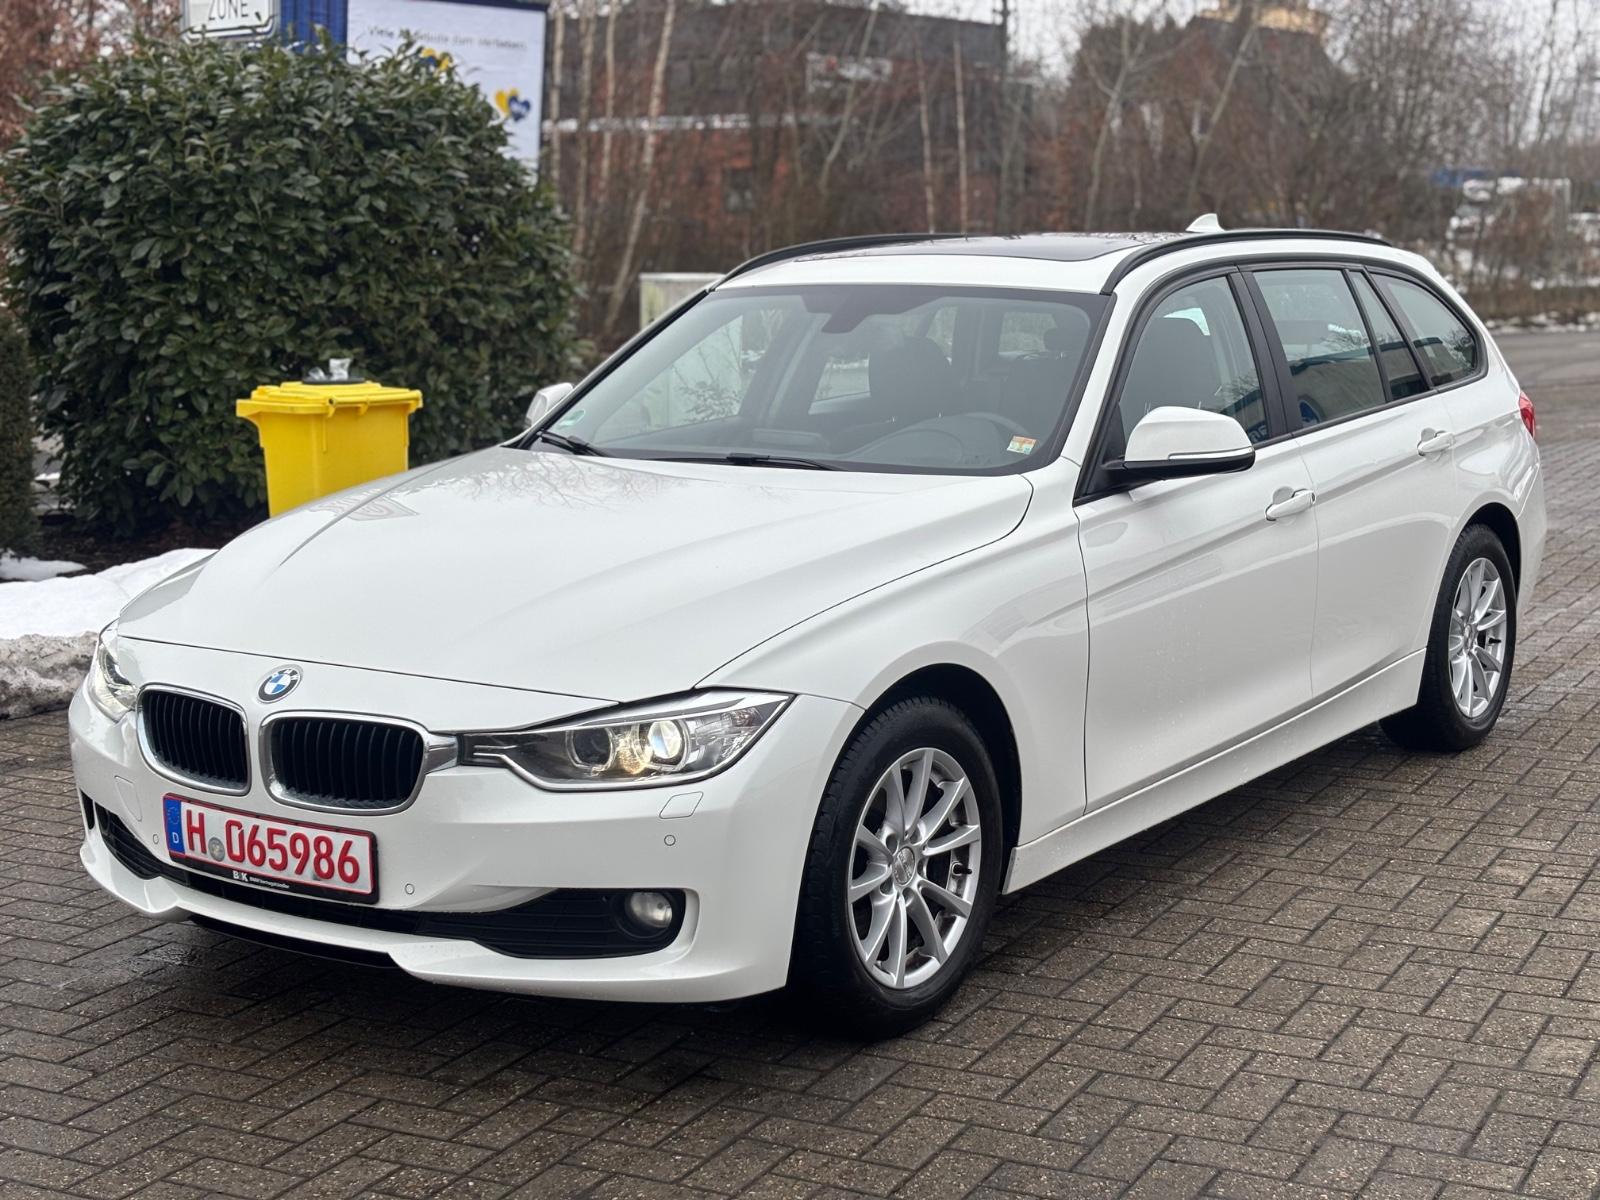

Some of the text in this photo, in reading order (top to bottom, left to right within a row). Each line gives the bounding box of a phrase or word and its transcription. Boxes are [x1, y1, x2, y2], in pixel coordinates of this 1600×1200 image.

[208, 0, 249, 20] ZONE
[172, 831, 180, 844] D
[186, 809, 360, 884] H 065986
